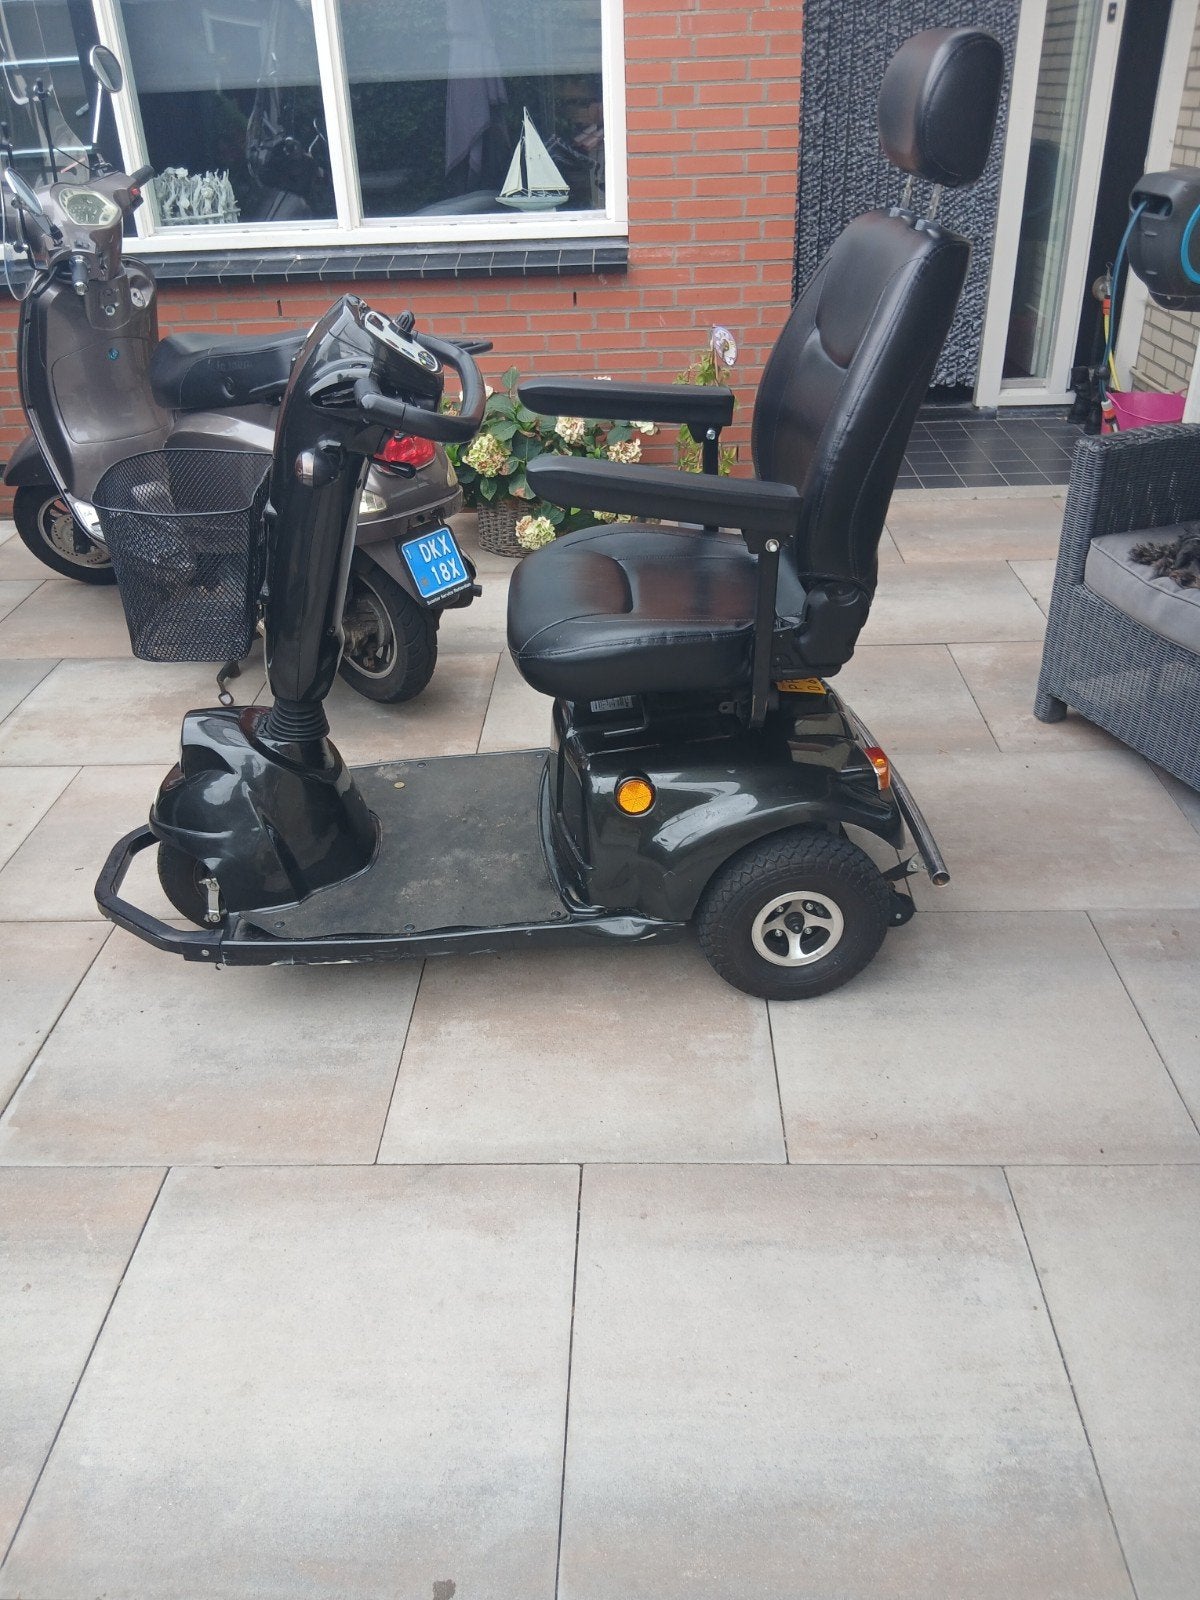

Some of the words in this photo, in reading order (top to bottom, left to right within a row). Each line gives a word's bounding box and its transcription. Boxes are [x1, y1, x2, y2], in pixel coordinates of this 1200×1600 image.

[406, 549, 412, 559] 1
[419, 535, 451, 563] DKX
[431, 558, 461, 585] 18X
